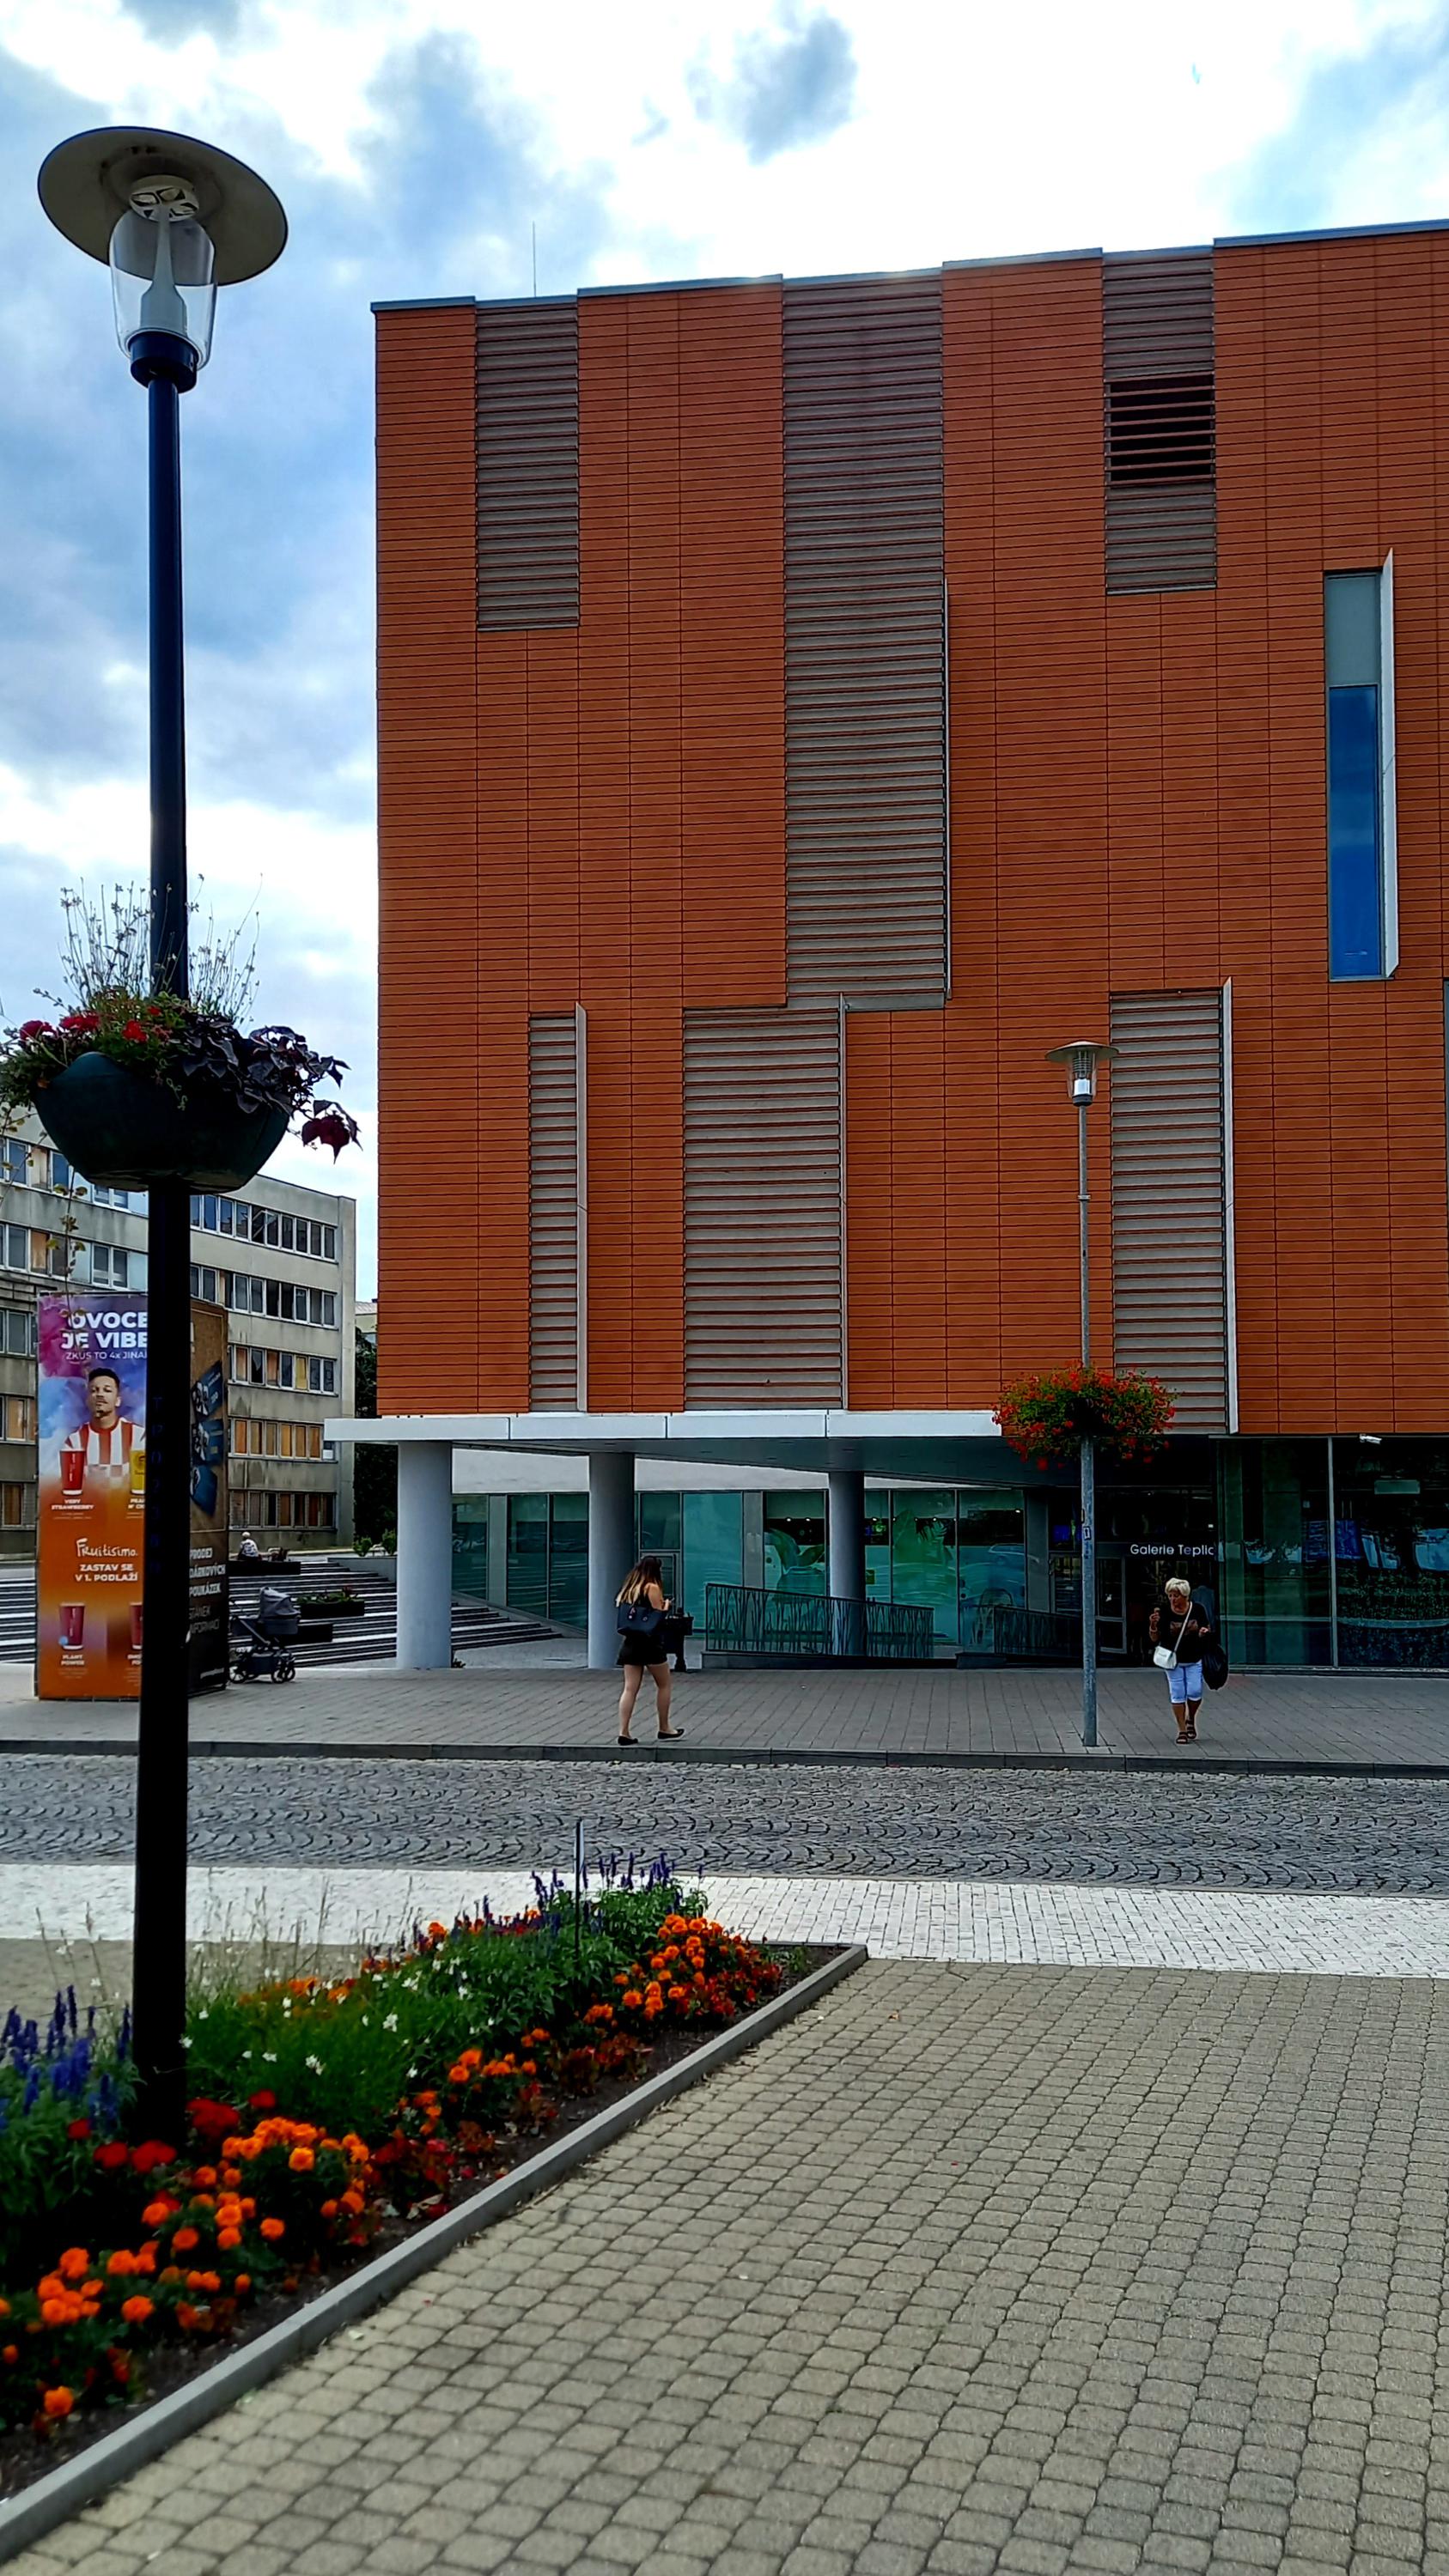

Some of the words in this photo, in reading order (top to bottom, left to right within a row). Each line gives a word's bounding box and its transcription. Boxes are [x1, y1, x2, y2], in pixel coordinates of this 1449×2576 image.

[69, 1311, 148, 1329] OVOCE
[61, 1332, 89, 1349] JE
[95, 1332, 148, 1348] VIBE
[65, 1352, 92, 1360] ZKUS
[1130, 1544, 1174, 1555] Galerie
[1178, 1544, 1215, 1557] Teplic
[80, 1564, 119, 1572] ZASTAV
[75, 1574, 83, 1583] V
[94, 1572, 138, 1582] PODLAŽÍ
